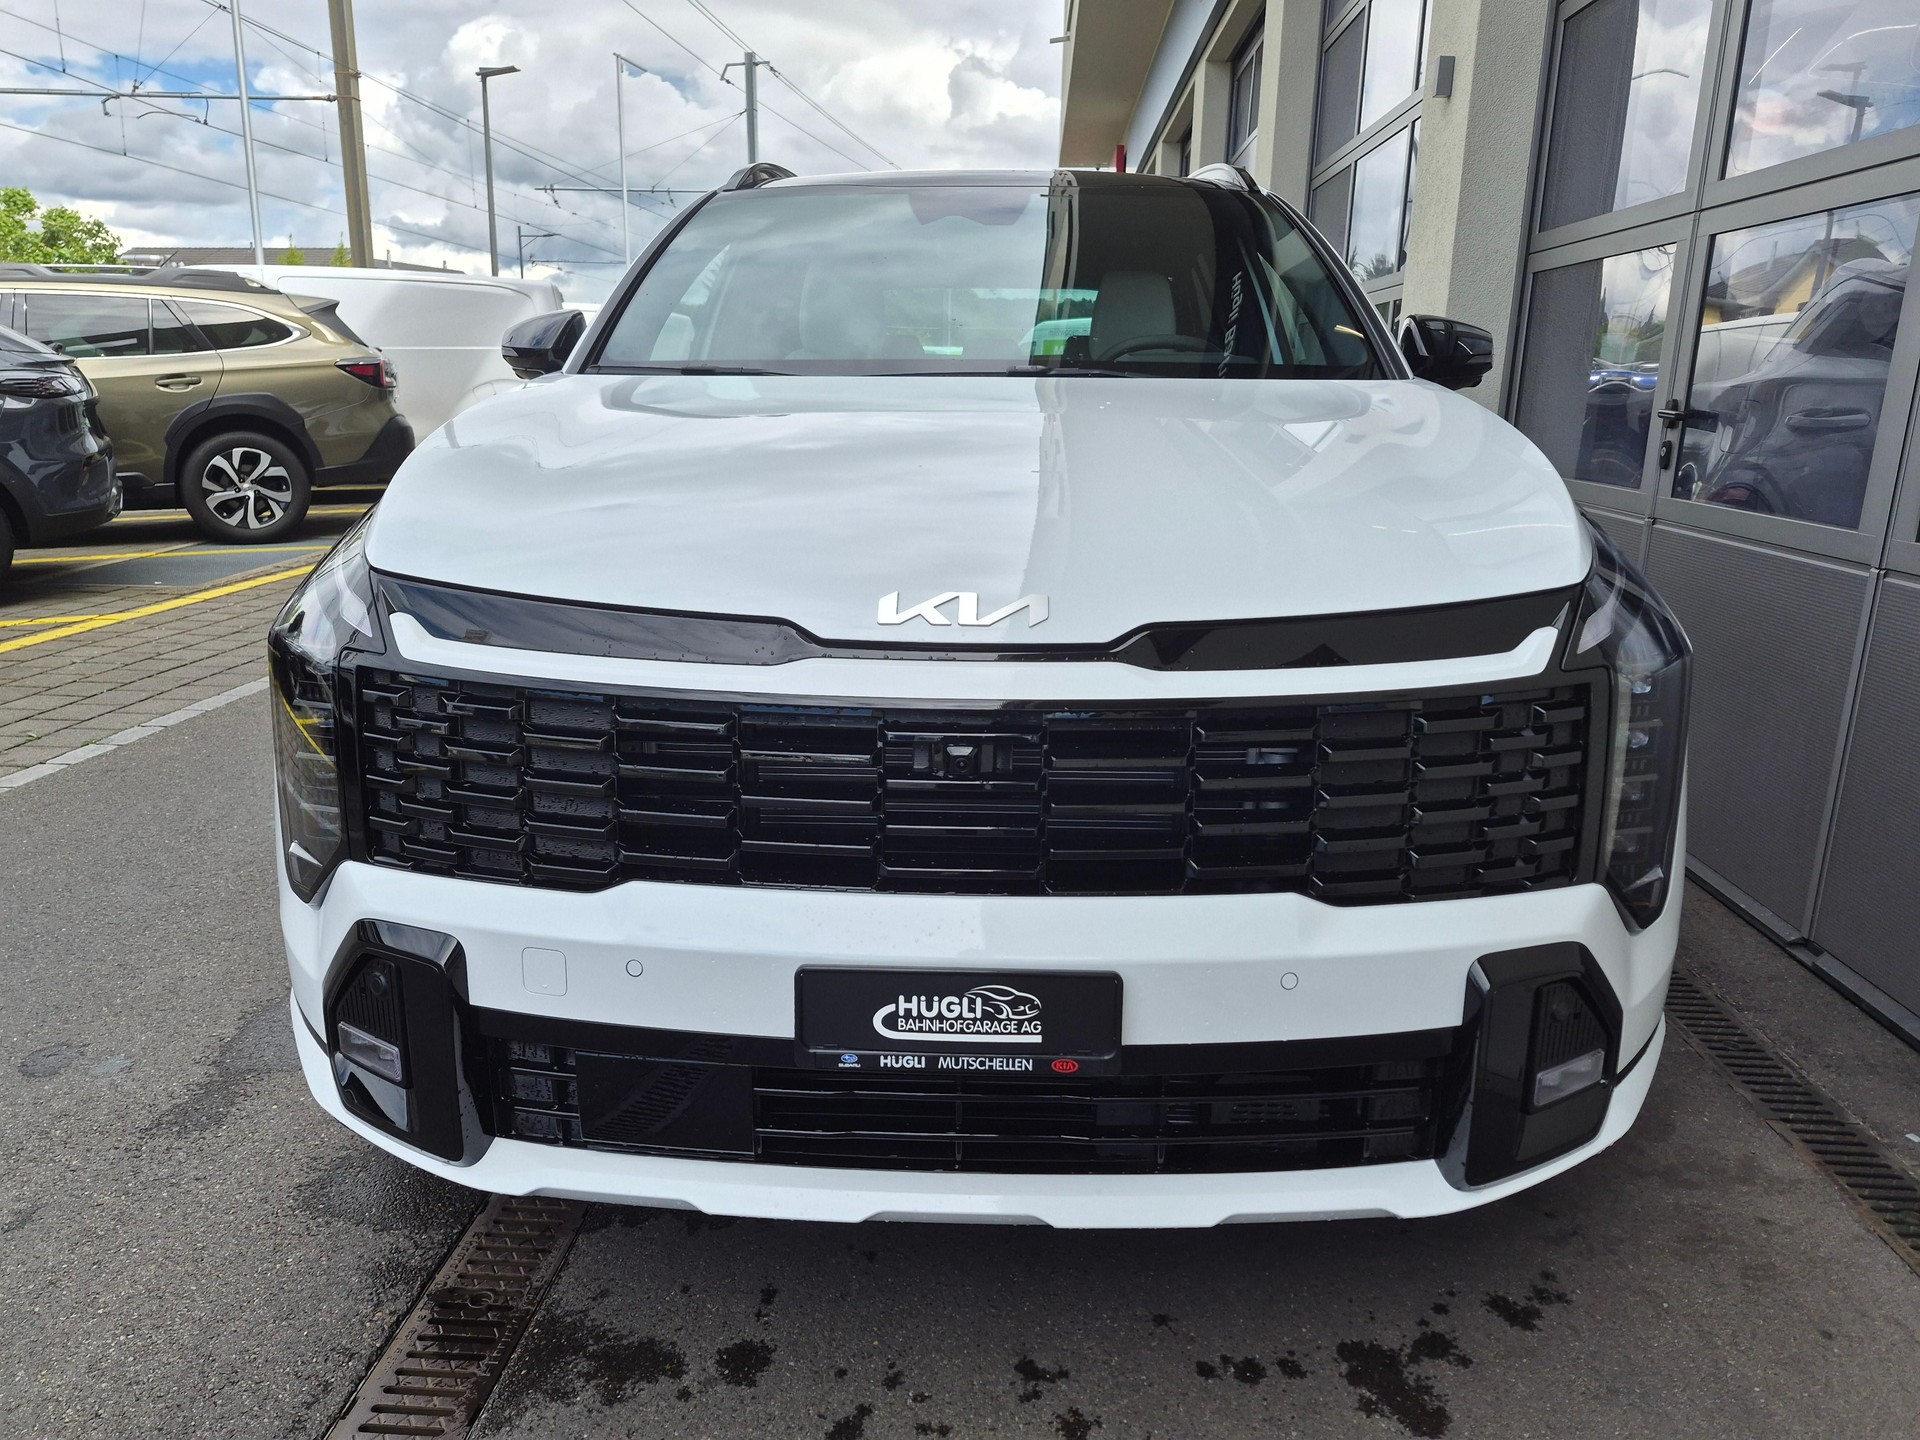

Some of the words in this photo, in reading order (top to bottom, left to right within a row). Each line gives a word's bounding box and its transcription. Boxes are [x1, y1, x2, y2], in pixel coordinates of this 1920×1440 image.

[877, 591, 1050, 628] KIA
[898, 995, 982, 1019] HÜGLI
[897, 1018, 1018, 1033] BAHNHOFGARAGE
[1020, 1020, 1042, 1034] AG
[880, 1055, 926, 1069] HÜGLI
[938, 1056, 1033, 1072] MUTSCHELLEN
